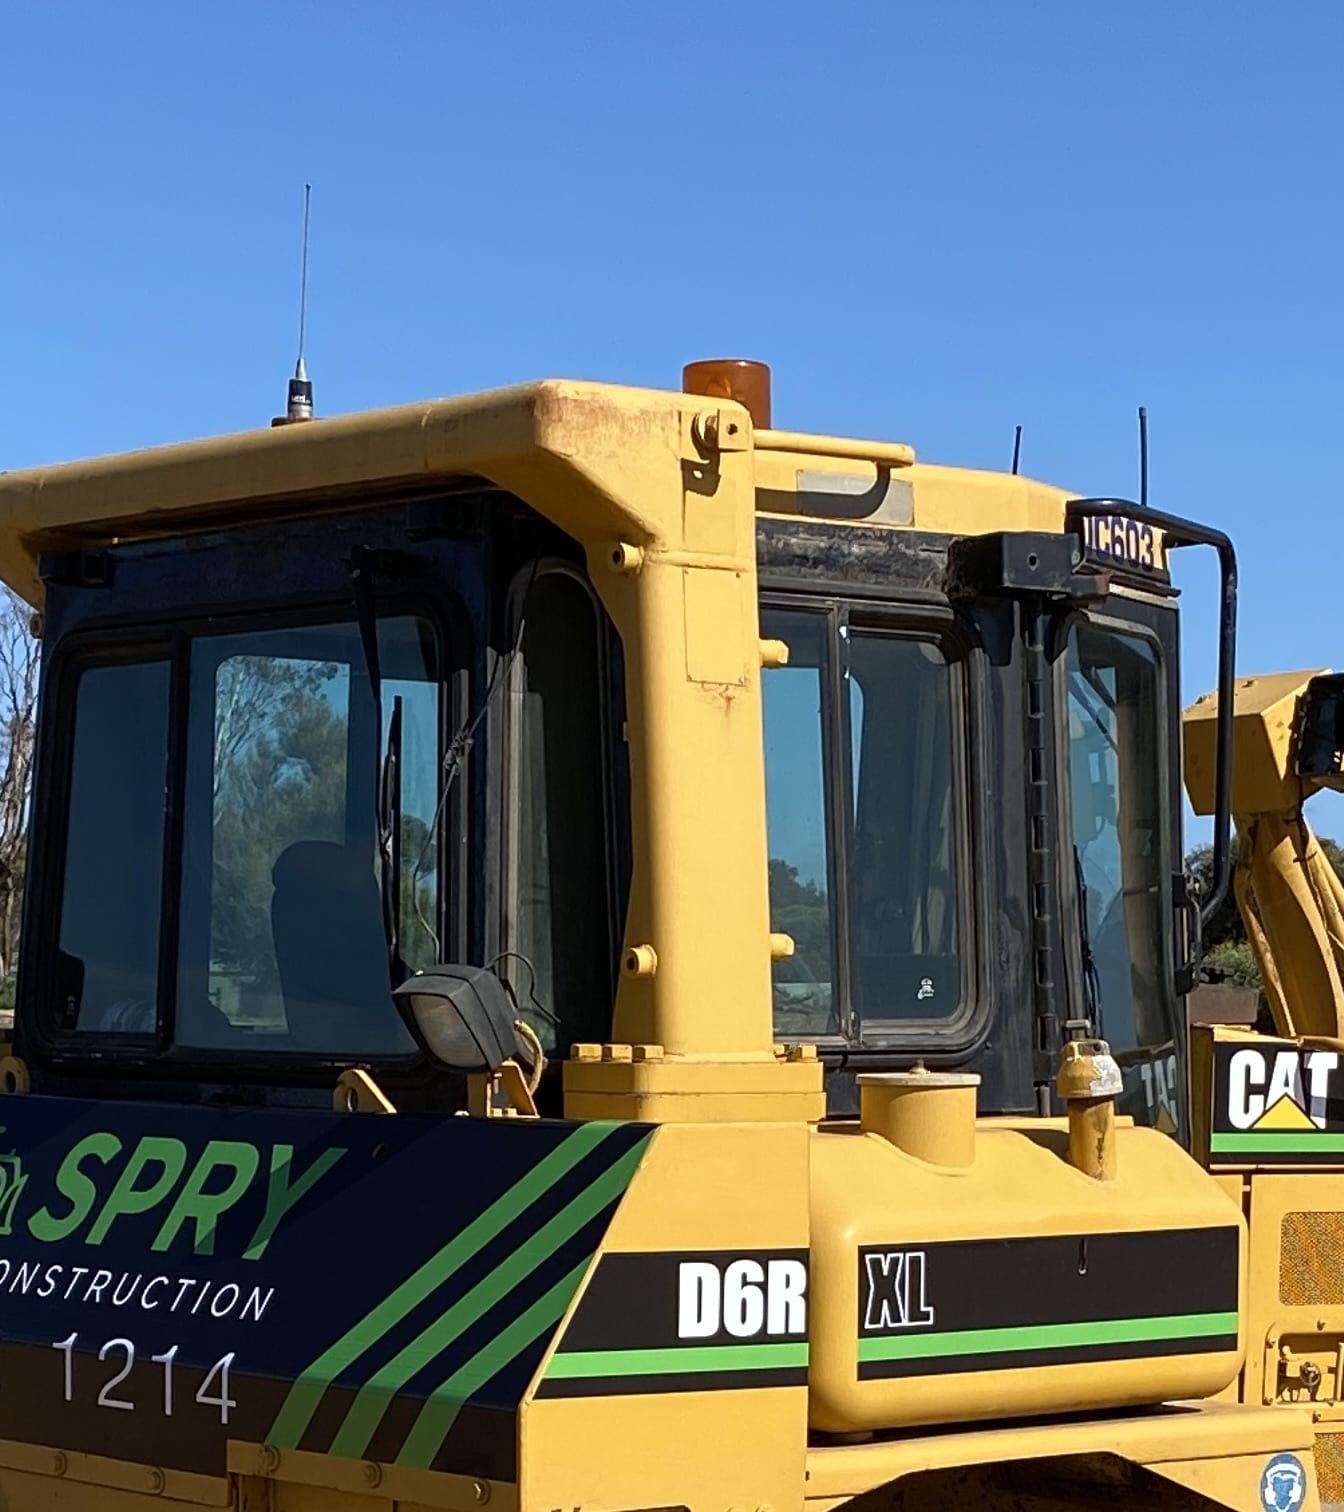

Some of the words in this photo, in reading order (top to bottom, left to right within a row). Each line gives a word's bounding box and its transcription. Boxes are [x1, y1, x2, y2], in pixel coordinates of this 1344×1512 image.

[1227, 1049, 1338, 1130] CAT
[27, 1131, 346, 1261] SPRY
[677, 1258, 808, 1340] D6R
[863, 1251, 935, 1330] XL
[53, 1332, 238, 1426] 1214
